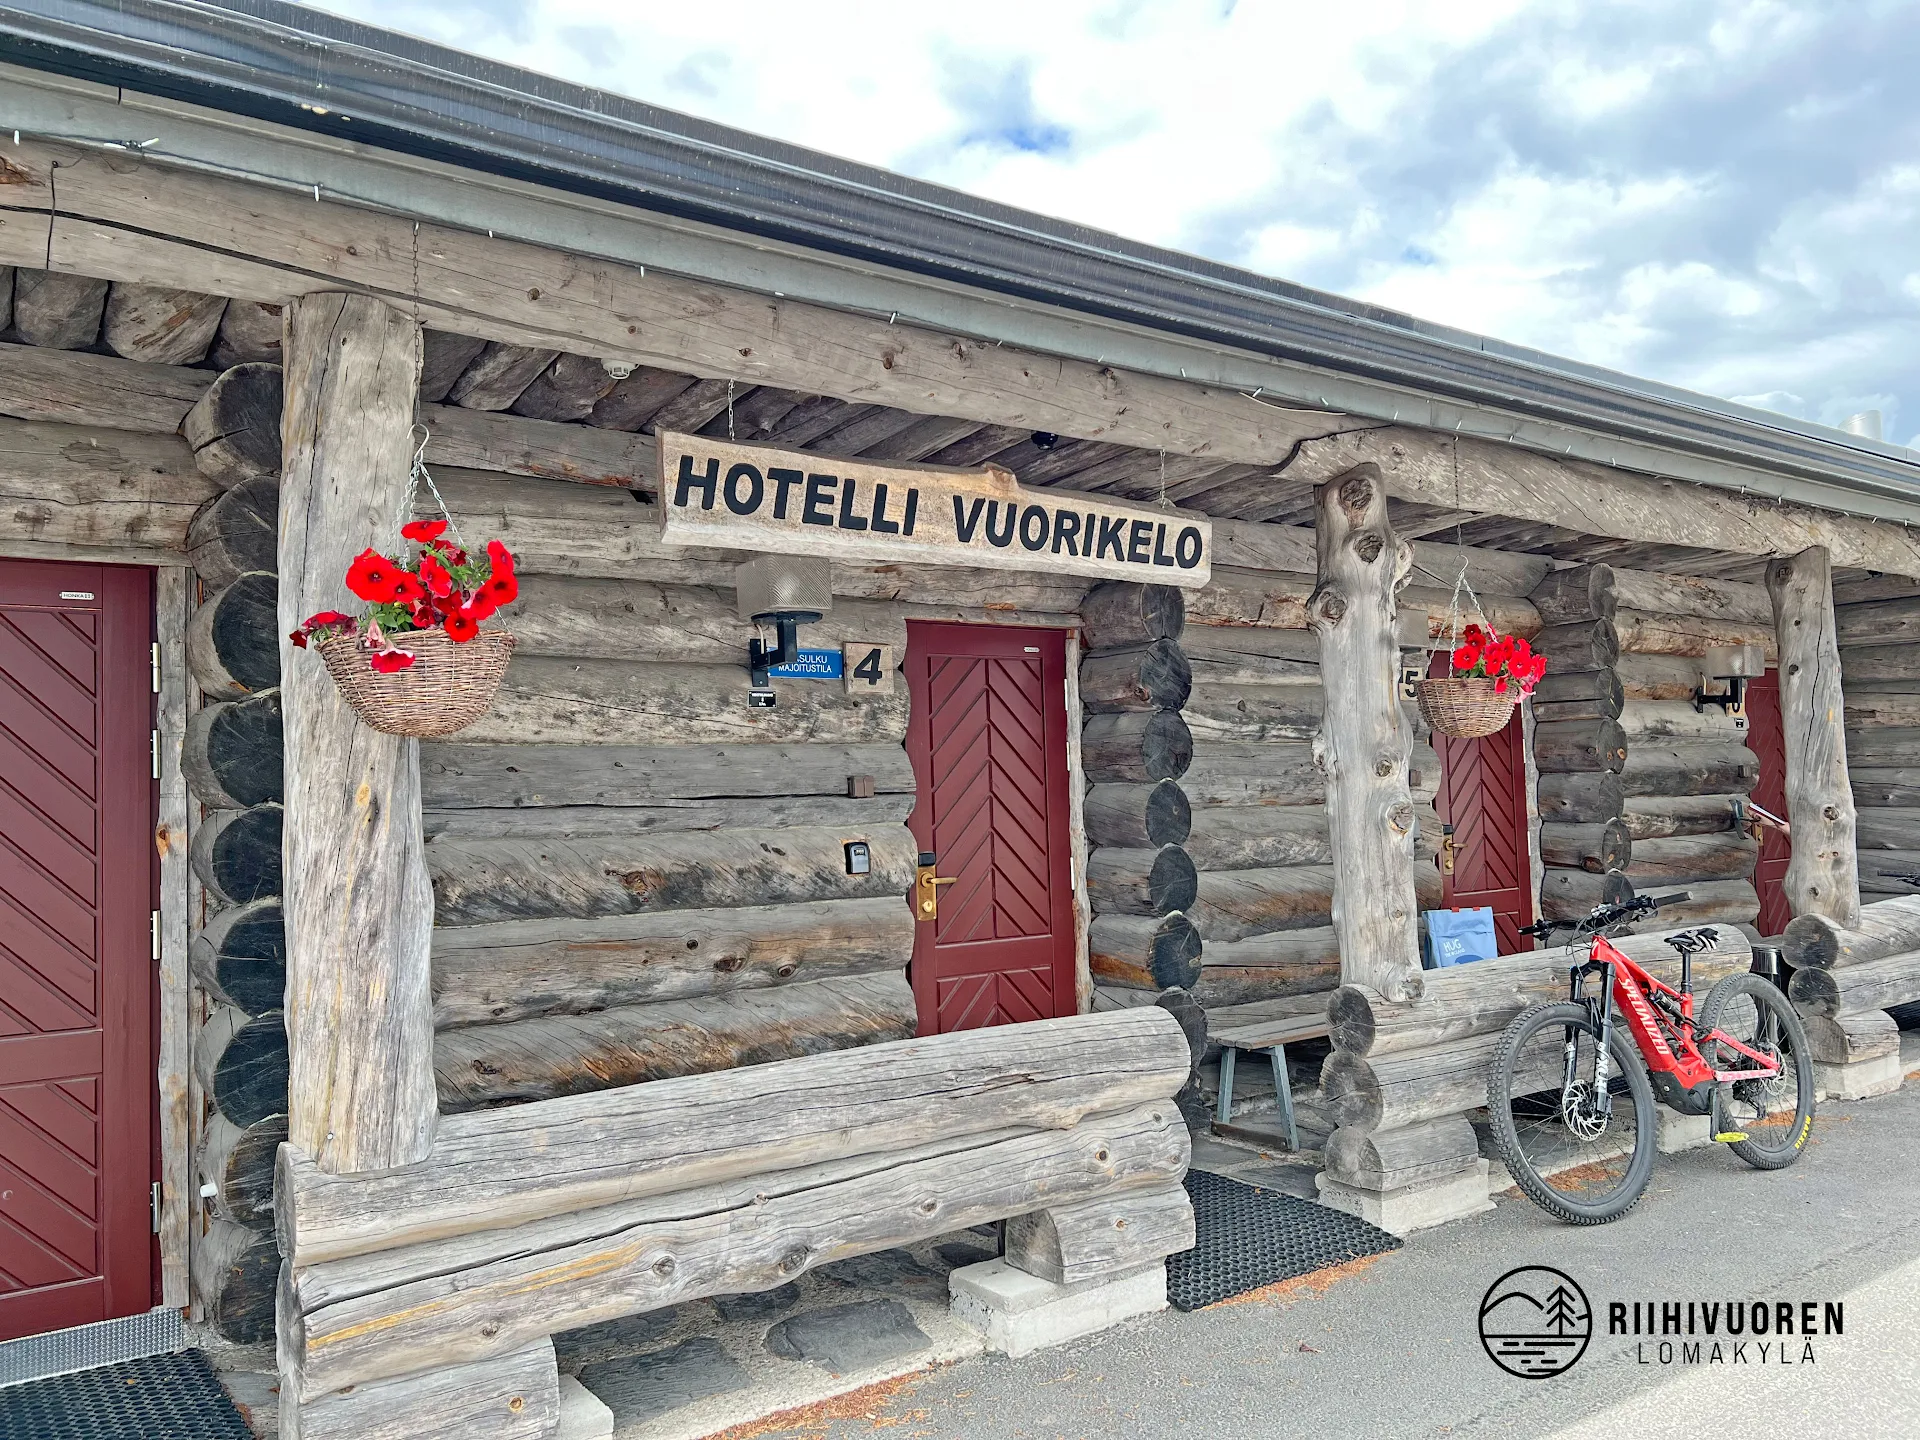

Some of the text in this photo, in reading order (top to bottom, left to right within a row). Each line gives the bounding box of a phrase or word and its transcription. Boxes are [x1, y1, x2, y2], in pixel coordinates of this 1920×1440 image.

[673, 454, 1203, 569] HOTELLI VUORIKELO
[778, 663, 833, 673] MAJOITUSTILA
[797, 654, 828, 664] SULKU
[853, 648, 883, 686] 4
[1404, 670, 1419, 698] 5
[1443, 938, 1462, 953] HUG
[1617, 977, 1670, 1055] SPECIALIZED
[1794, 1115, 1812, 1149] MAXXIS
